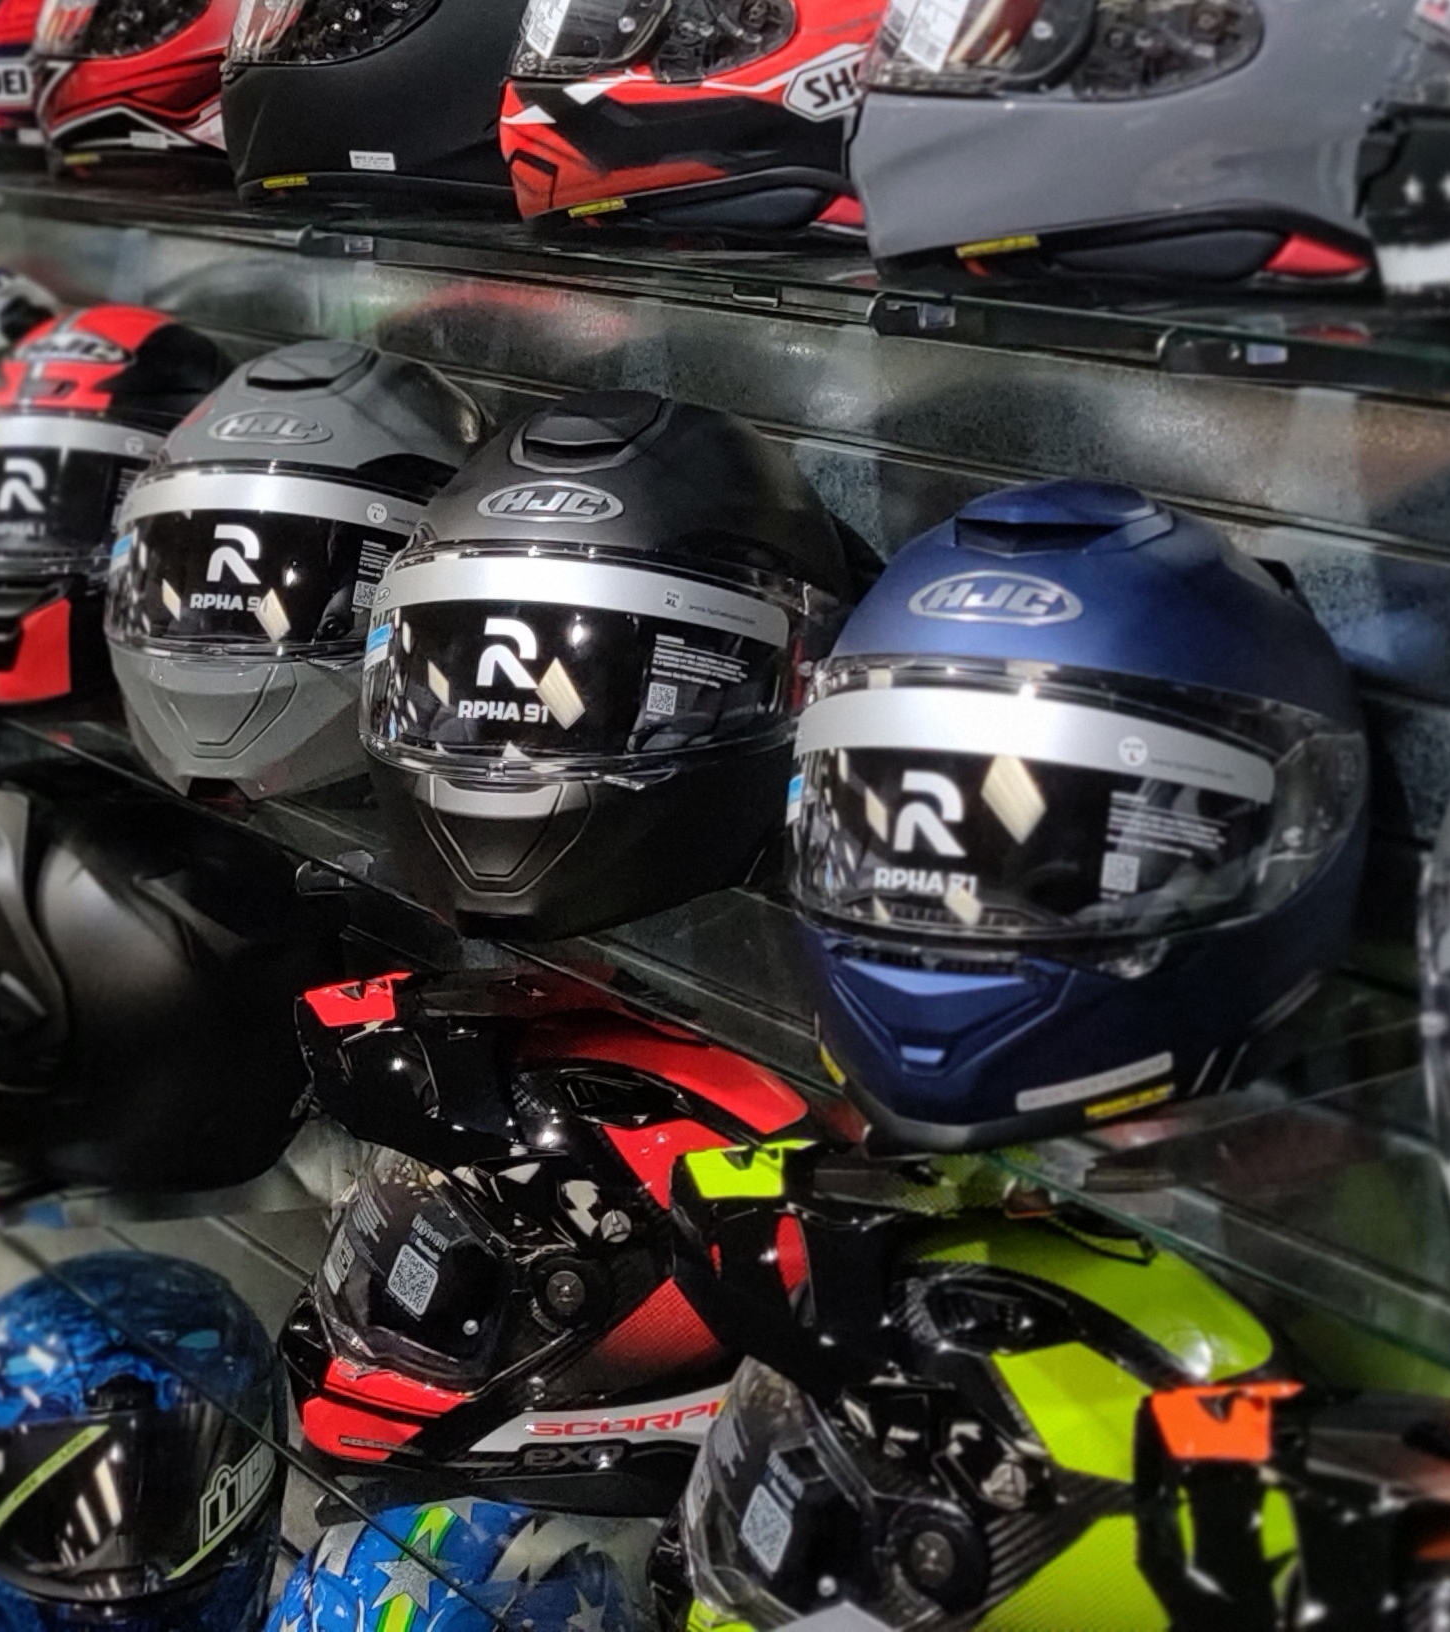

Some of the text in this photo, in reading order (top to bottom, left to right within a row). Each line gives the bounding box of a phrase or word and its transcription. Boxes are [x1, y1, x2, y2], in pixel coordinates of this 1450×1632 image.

[221, 414, 320, 440] HJC
[493, 490, 607, 515] HJC
[190, 593, 244, 611] RPHA
[931, 586, 1057, 618] HJC
[457, 701, 550, 723] RPHA 91
[874, 867, 944, 894] RPHA
[531, 1400, 722, 1437] SCORPI
